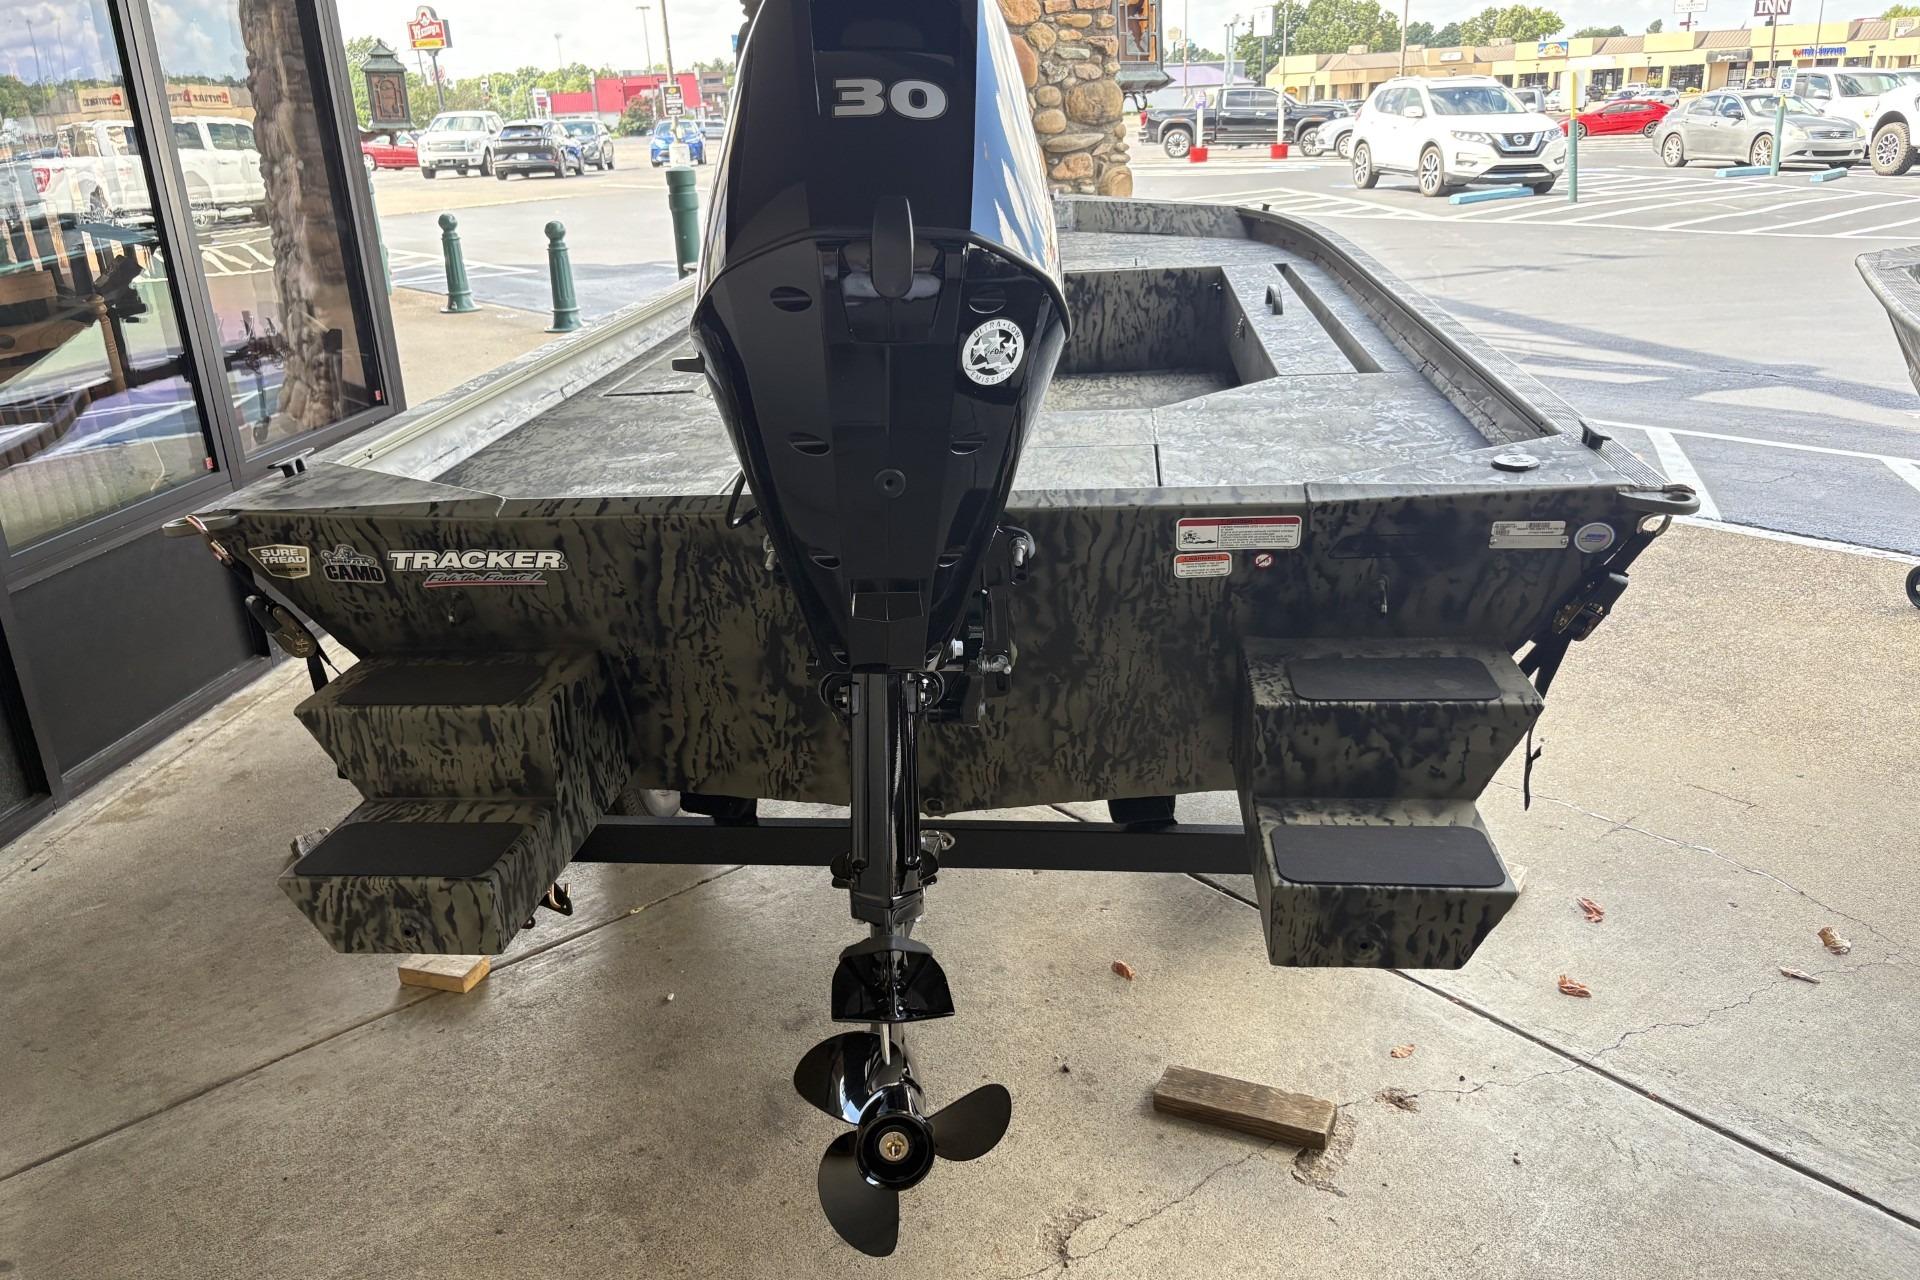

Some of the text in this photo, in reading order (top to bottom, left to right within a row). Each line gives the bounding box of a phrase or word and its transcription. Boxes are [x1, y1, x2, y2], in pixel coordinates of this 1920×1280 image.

[1757, 0, 1789, 14] INN
[833, 79, 948, 119] 30
[260, 548, 299, 557] SURE
[260, 556, 306, 565] TREAD
[390, 551, 563, 570] TRACKER
[325, 564, 384, 581] CAMO
